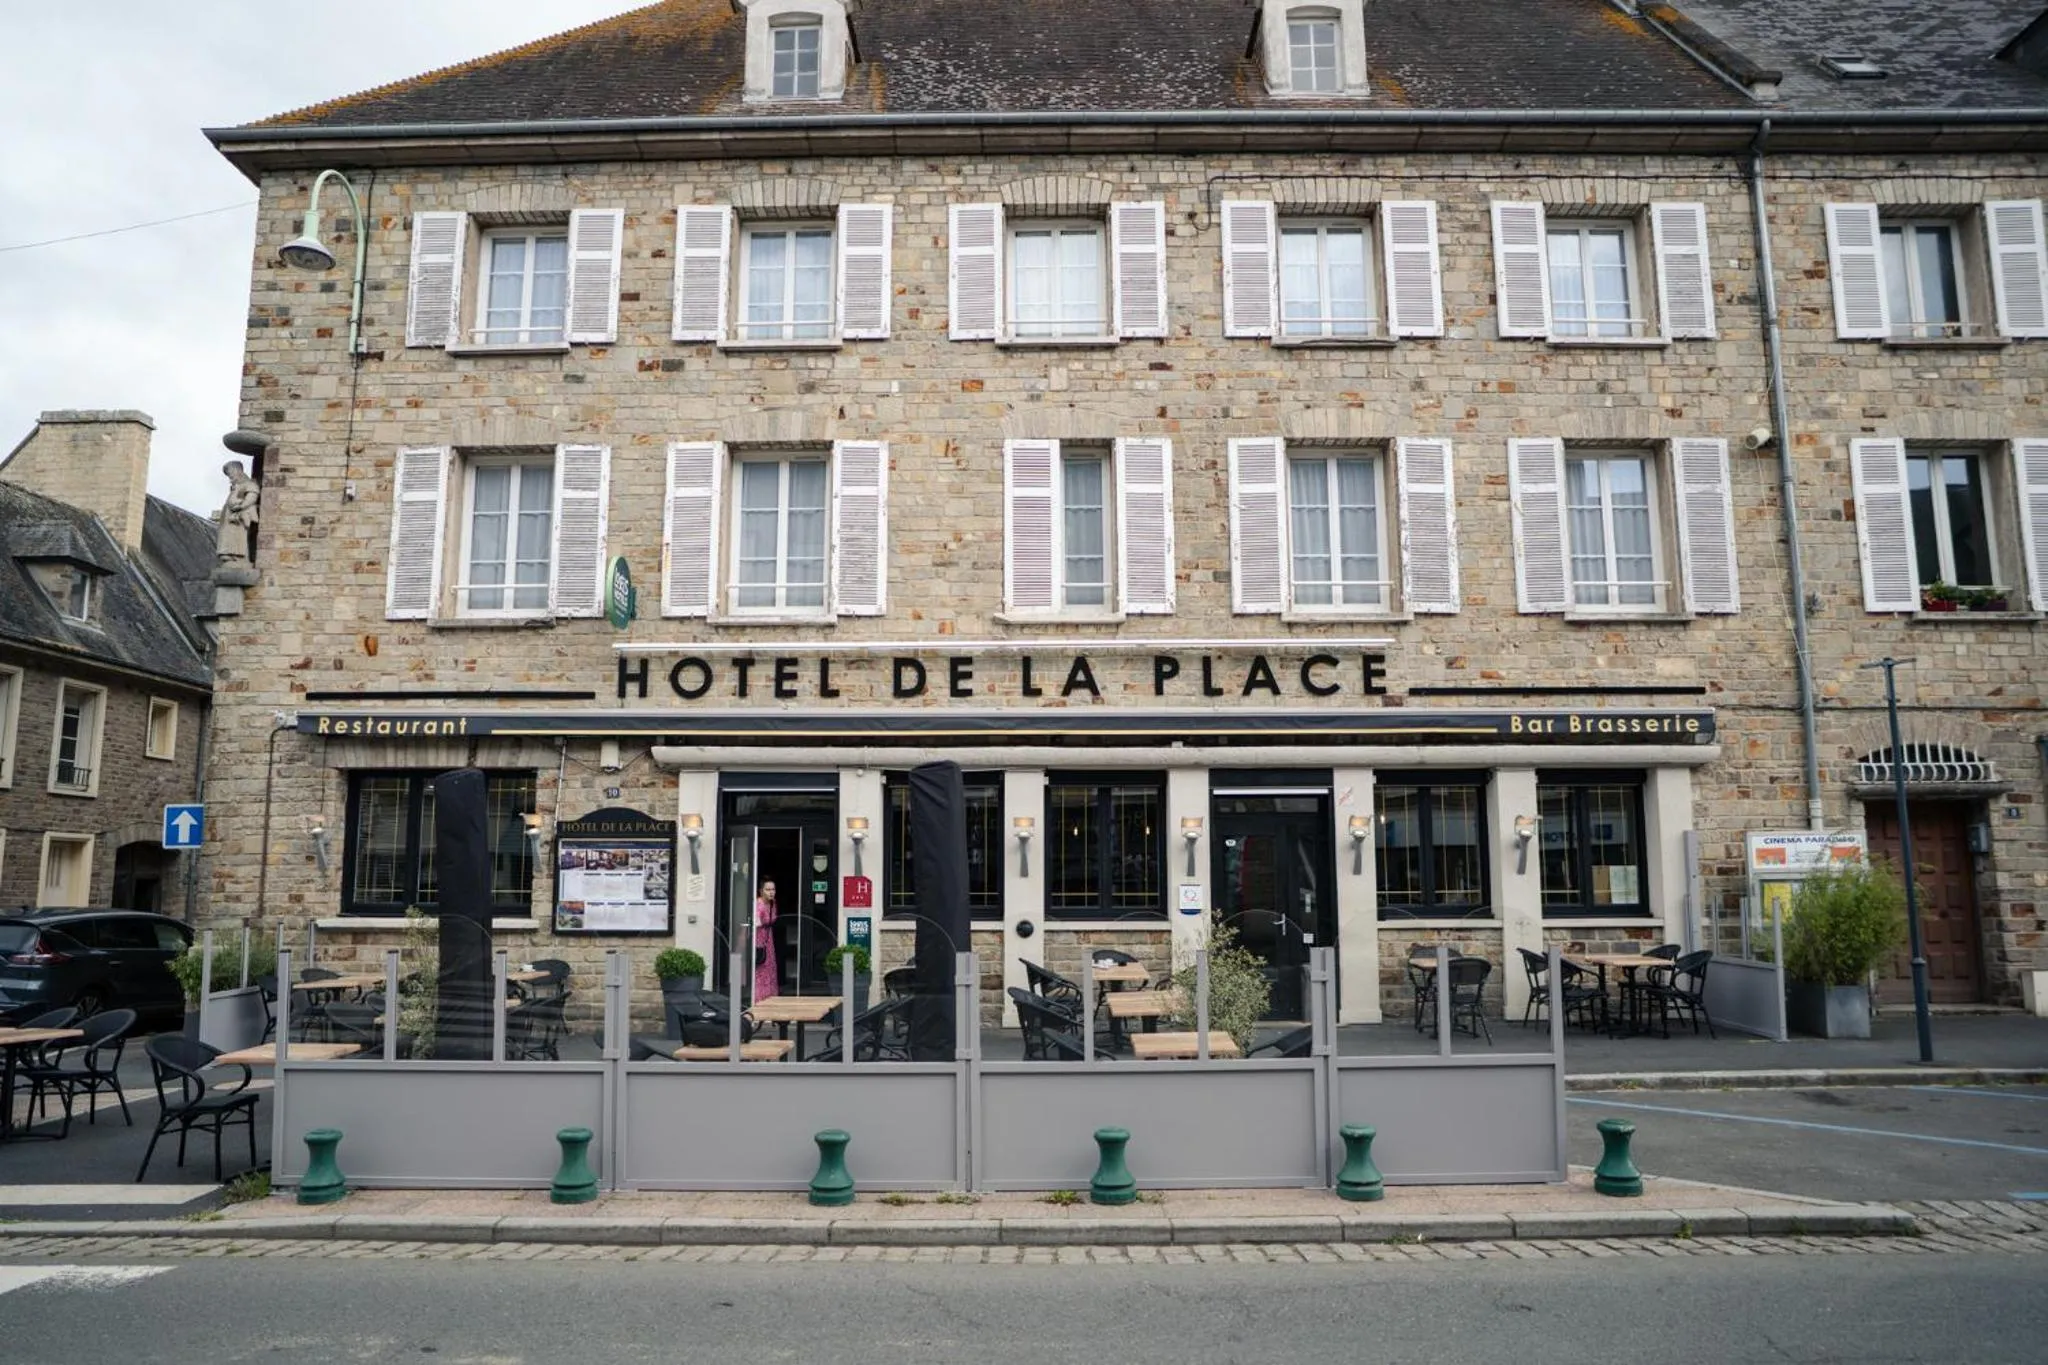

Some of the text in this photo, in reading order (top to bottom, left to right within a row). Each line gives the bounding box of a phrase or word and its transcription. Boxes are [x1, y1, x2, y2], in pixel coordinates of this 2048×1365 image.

[617, 653, 1388, 699] HOTEL DE LA PLACE
[317, 716, 469, 735] Restaurant
[1510, 713, 1700, 733] Bar Brasserie
[619, 822, 633, 833] LA
[635, 822, 670, 833] PLACE
[857, 881, 868, 894] H
